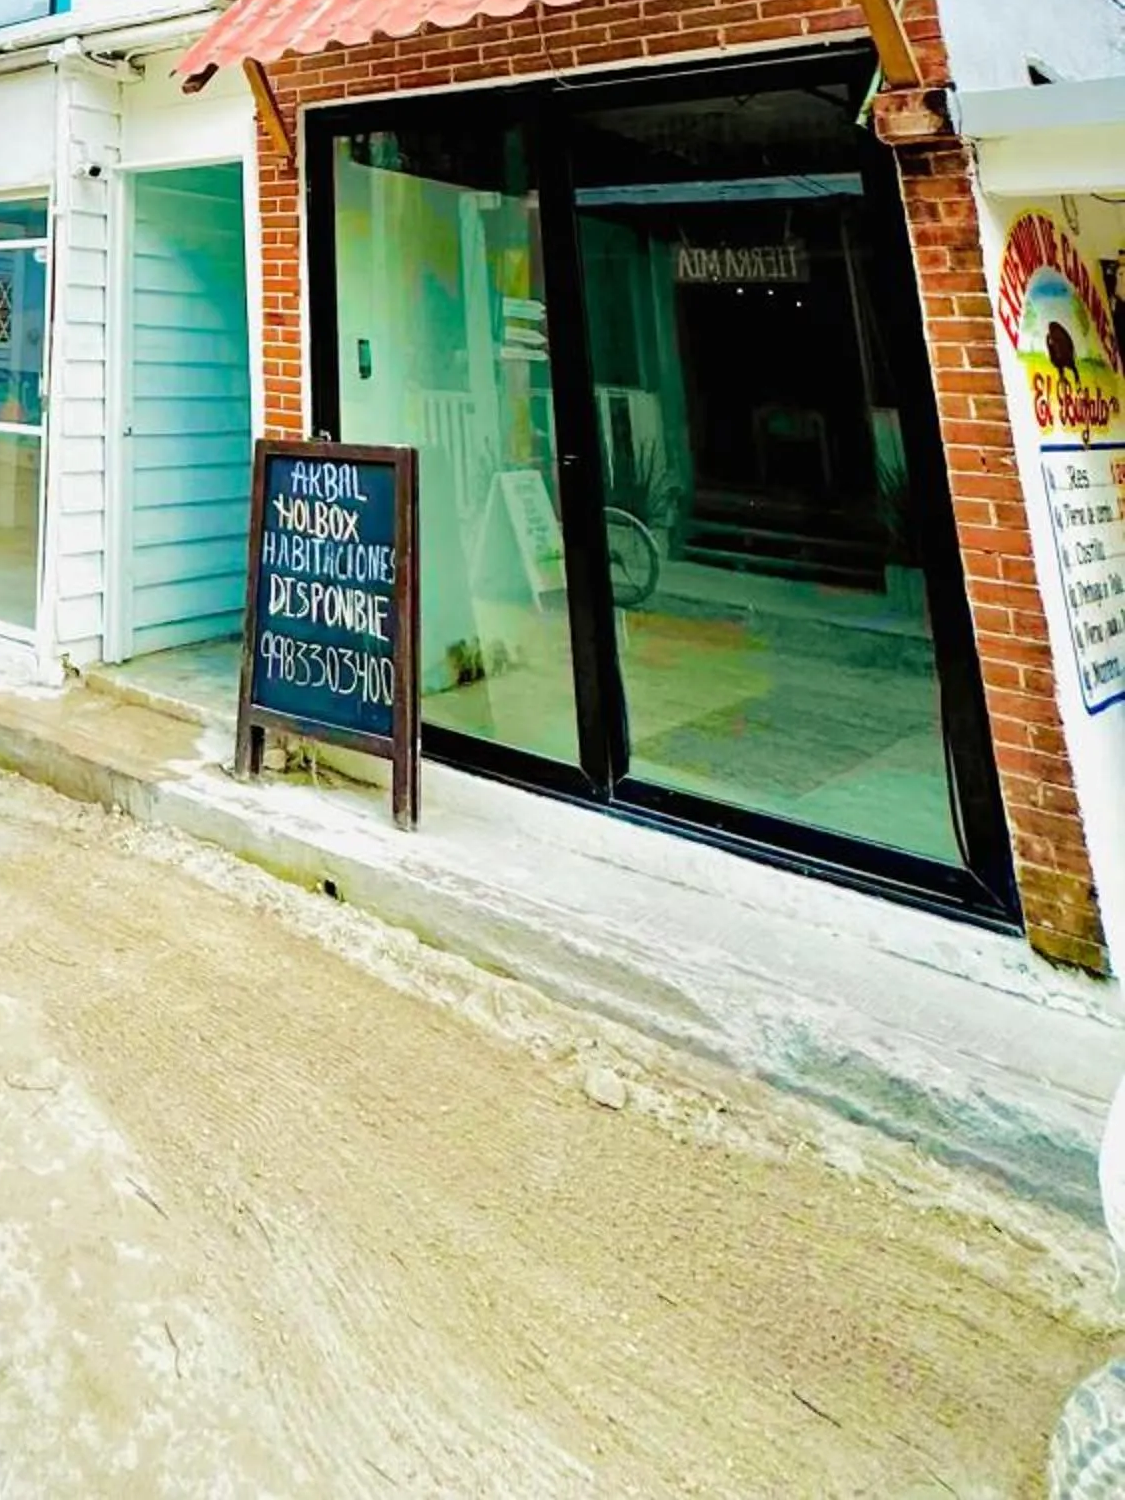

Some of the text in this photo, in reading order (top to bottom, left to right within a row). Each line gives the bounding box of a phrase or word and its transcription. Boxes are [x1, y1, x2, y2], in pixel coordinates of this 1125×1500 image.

[291, 460, 368, 503] AKBAL
[273, 493, 360, 543] HOLBOX
[260, 629, 394, 706] 9983303400
